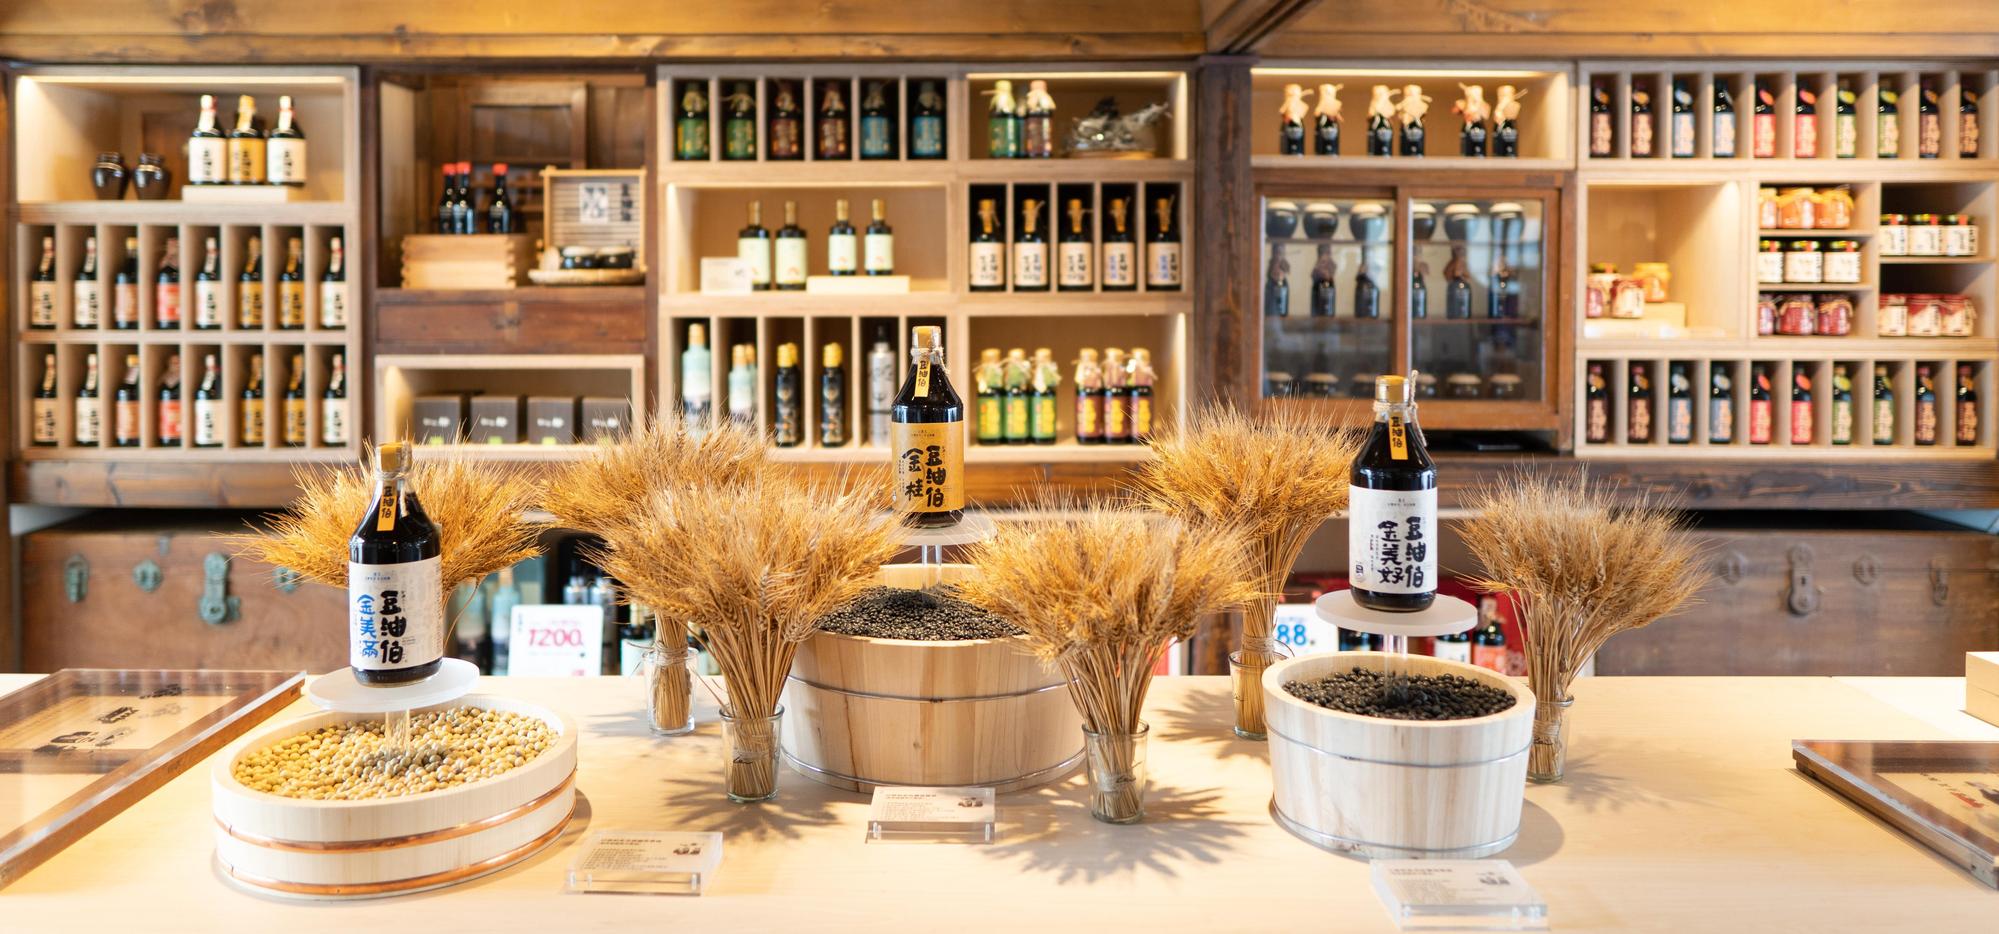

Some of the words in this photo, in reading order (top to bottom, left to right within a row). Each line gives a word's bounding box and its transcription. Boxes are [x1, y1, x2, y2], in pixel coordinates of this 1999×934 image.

[918, 360, 929, 388] 豆油伯
[1391, 416, 1403, 448] 豆油伯
[381, 486, 394, 519] 豆油伯
[902, 447, 924, 502] 金桂
[925, 445, 947, 508] 豆油伯
[1378, 520, 1404, 585] 金美好
[1404, 516, 1426, 588] 豆油伯
[379, 590, 407, 665] 豆油伯
